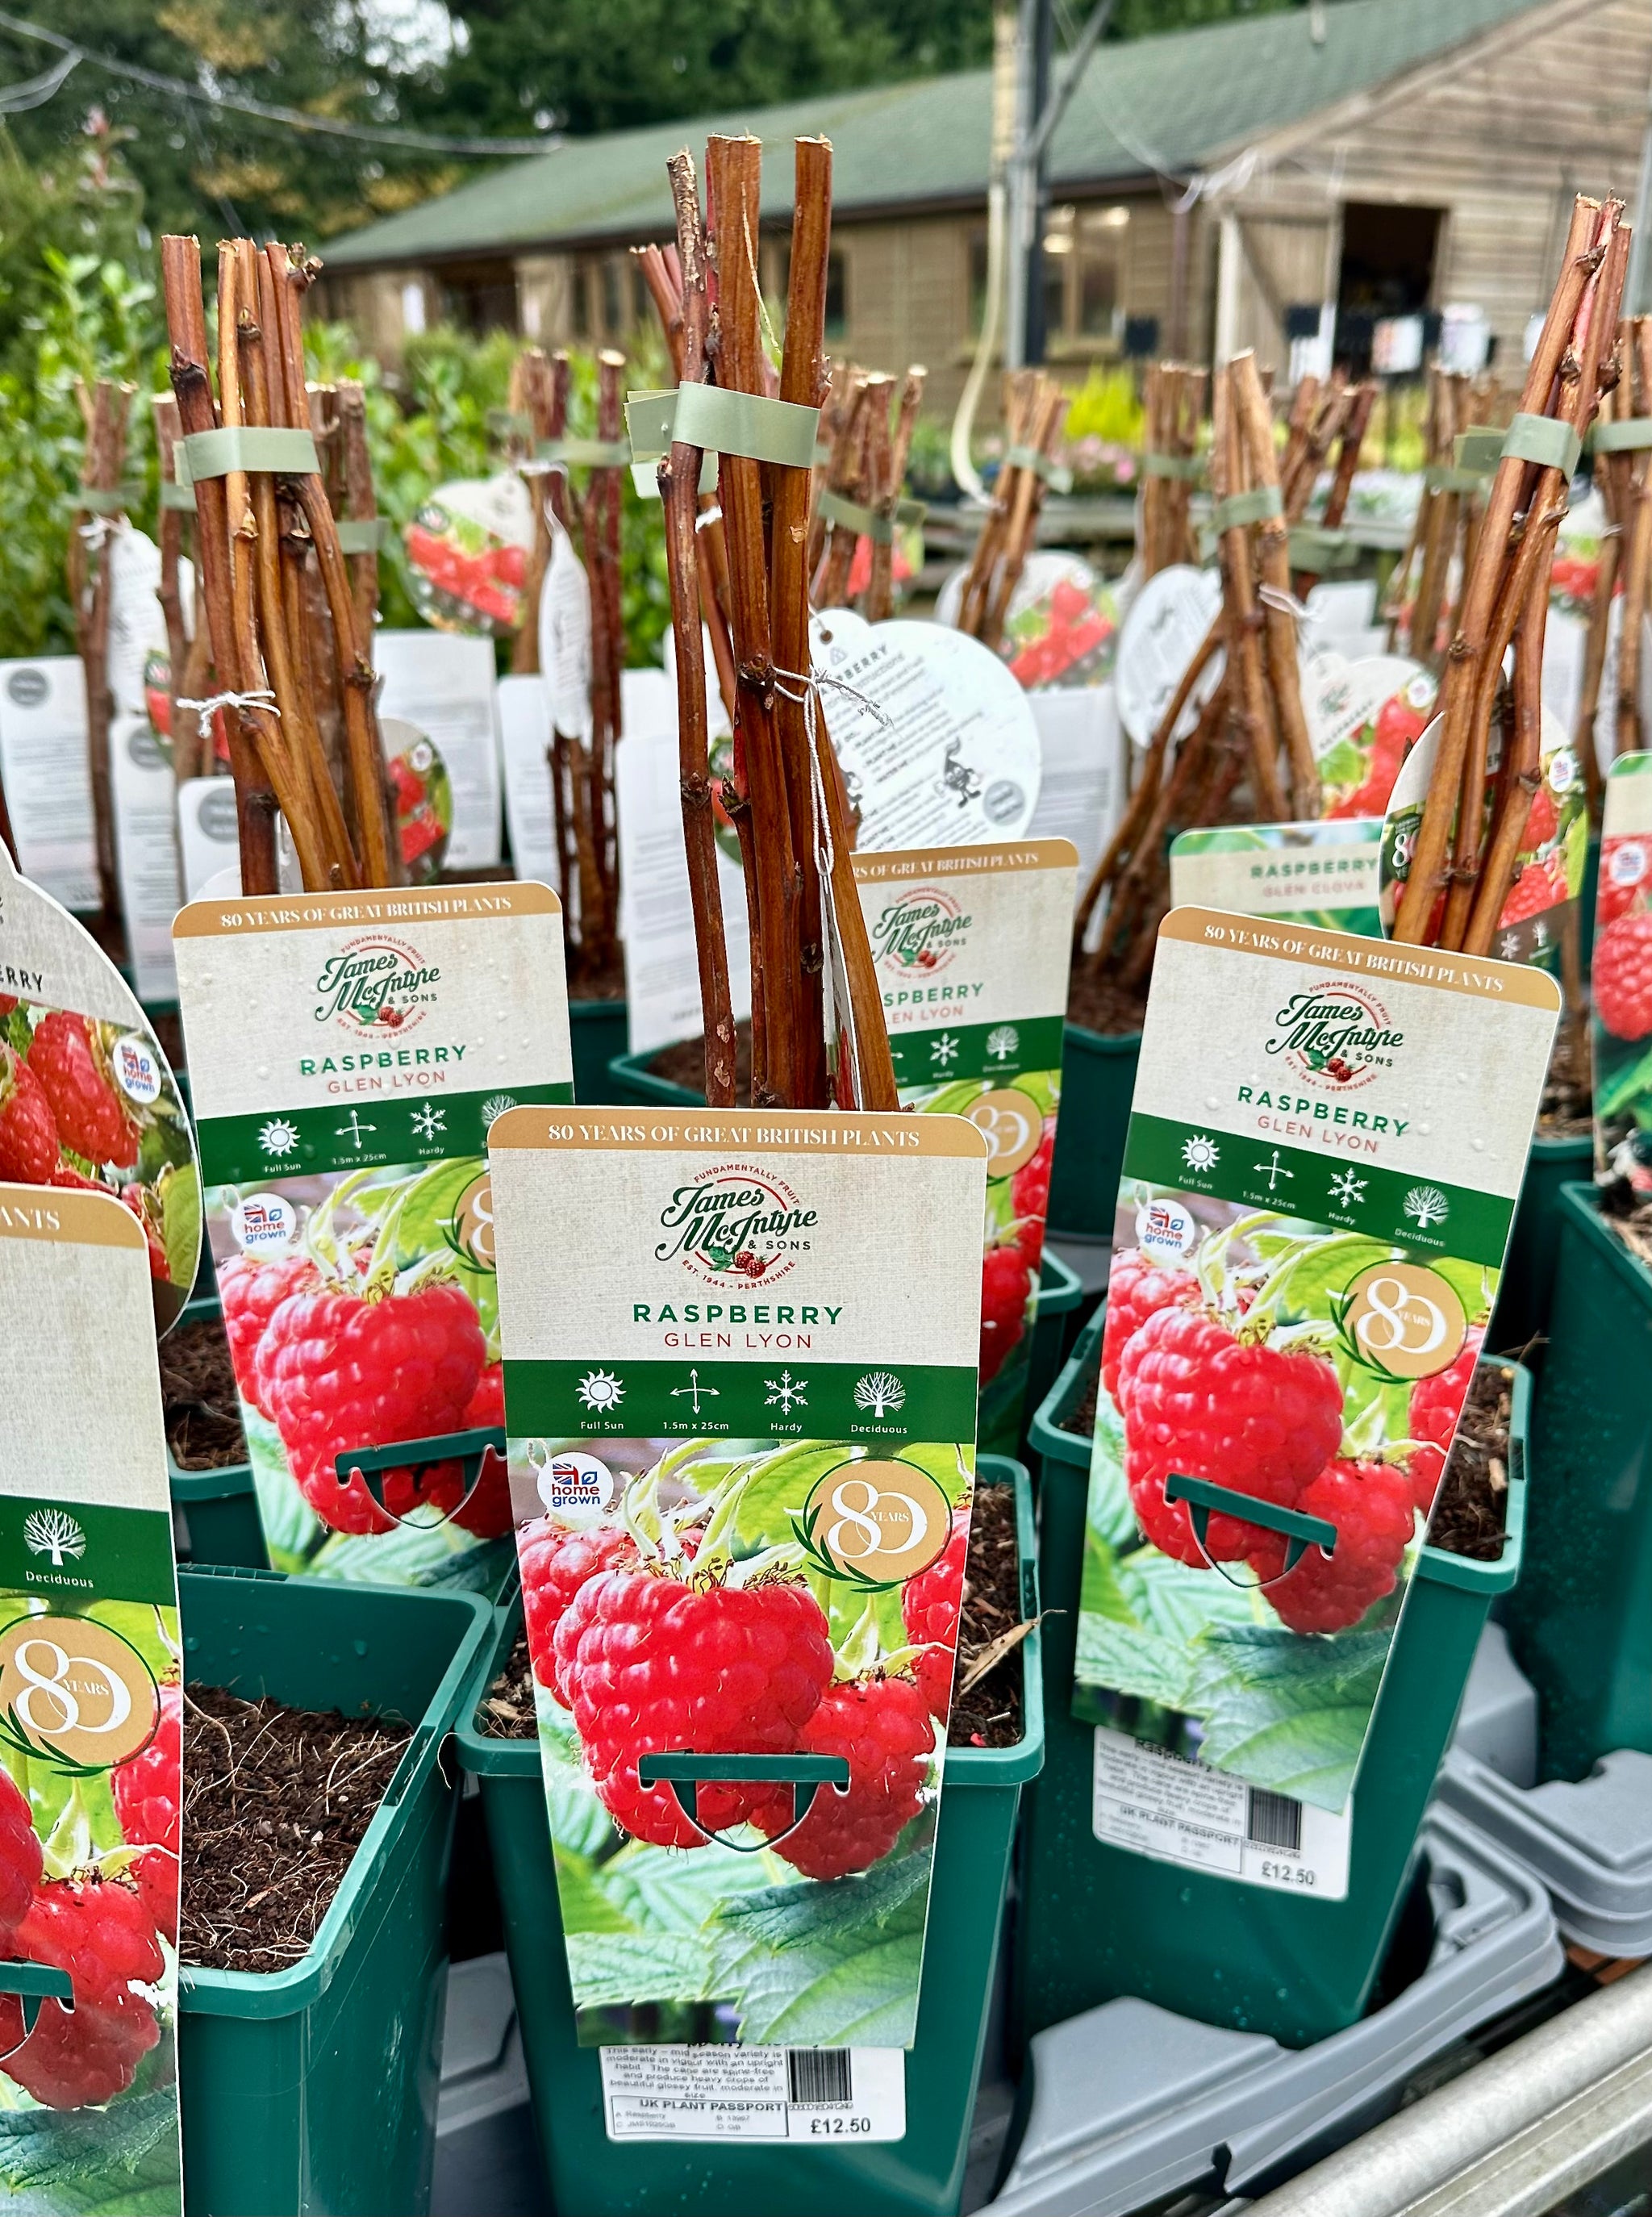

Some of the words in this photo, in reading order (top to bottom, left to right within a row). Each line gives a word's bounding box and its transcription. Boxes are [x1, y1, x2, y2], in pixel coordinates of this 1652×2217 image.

[891, 859, 933, 875] GREAT
[937, 855, 987, 871] BRITISH
[990, 852, 1039, 867] PLANTS
[1250, 858, 1377, 879] RASPBERRY
[221, 913, 242, 927] 80
[245, 910, 300, 926] YEARS
[303, 908, 327, 921] OF
[330, 904, 383, 920] GREAT
[386, 900, 449, 916] BRITISH
[453, 896, 512, 912] PLANTS
[872, 902, 941, 940] James
[871, 916, 973, 963] McIntyre
[937, 937, 967, 948] SONS
[1204, 925, 1225, 940] 80
[1229, 929, 1280, 950] YEARS
[1283, 938, 1307, 954] OF
[1308, 943, 1363, 966] GREAT
[1366, 954, 1435, 980] BRITISH
[1437, 967, 1505, 992] PLANTS
[317, 952, 398, 993] James
[315, 967, 441, 1021] McIntyre
[388, 996, 395, 1005] &
[403, 992, 438, 1004] SONS
[883, 982, 983, 1008] SPBERRY
[920, 1004, 964, 1021] LYON
[1275, 994, 1364, 1027] James
[1265, 1021, 1404, 1058] McIntyre
[299, 1045, 467, 1076] RASPBERRY
[1340, 1049, 1348, 1058] &
[1355, 1052, 1394, 1067] SONS
[123, 1063, 153, 1082] home
[126, 1077, 156, 1093] grown
[328, 1077, 383, 1094] GLEN
[394, 1070, 445, 1088] LYON
[1237, 1086, 1409, 1137] RASPBERRY
[549, 1124, 574, 1141] 80
[578, 1125, 646, 1142] YEARS
[650, 1125, 680, 1142] OF
[684, 1126, 752, 1143] GREAT
[757, 1127, 836, 1145] BRITISH
[843, 1129, 920, 1147] PLANTS
[1258, 1115, 1312, 1138] GLEN
[1322, 1129, 1379, 1153] LYON
[363, 1154, 387, 1163] 25cm
[419, 1146, 445, 1155] Hardy
[264, 1164, 282, 1173] Full
[284, 1163, 302, 1171] Sun
[693, 1163, 778, 1184] FUNDAMENTALLY
[778, 1180, 801, 1206] FRUIT
[1178, 1175, 1195, 1186] Full
[1196, 1179, 1213, 1190] Sun
[661, 1183, 765, 1227] James
[1271, 1197, 1295, 1209] 25cm
[0, 1206, 60, 1231] ANTS
[244, 1221, 285, 1234] home
[1328, 1212, 1356, 1225] Hardy
[245, 1228, 286, 1244] grown
[654, 1209, 819, 1262] McIntyre
[1145, 1222, 1183, 1240] home
[1394, 1227, 1446, 1247] Deciduous
[747, 1239, 757, 1250] &
[766, 1240, 811, 1250] SONS
[1145, 1234, 1183, 1249] grown
[682, 1259, 699, 1277] EST.
[703, 1275, 725, 1288] 1944
[737, 1260, 796, 1290] PERTHSHIRE
[632, 1304, 844, 1325] RASPBERRY
[1357, 1277, 1447, 1354] 80
[1397, 1309, 1431, 1327] YEARS
[665, 1332, 732, 1348] GLEN
[746, 1333, 811, 1349] LYON
[580, 1421, 603, 1430] Full
[604, 1421, 624, 1430] Sun
[662, 1422, 688, 1430] 1.5m
[700, 1422, 729, 1430] 25cm
[770, 1422, 803, 1434] Hardy
[850, 1424, 908, 1434] Deciduous
[552, 1483, 600, 1496] home
[553, 1495, 600, 1508] grown
[828, 1480, 928, 1558] 80
[870, 1511, 909, 1522] YEARS
[26, 1570, 94, 1589] Deciduous
[14, 1639, 131, 1734] 80
[62, 1678, 111, 1696] YEARS
[1178, 1822, 1239, 1845] PASSPORT
[1262, 1860, 1315, 1885] £12.50
[607, 2054, 656, 2063] moderate
[748, 2059, 783, 2067] upright
[632, 2047, 657, 2056] early
[693, 2050, 731, 2058] season
[734, 2049, 768, 2058] variety
[646, 2073, 688, 2081] produce
[691, 2075, 722, 2083] heavy
[640, 2098, 659, 2107] UK
[662, 2100, 707, 2110] PLANT
[710, 2102, 783, 2111] PASSPORT
[811, 2117, 871, 2134] £12.50
